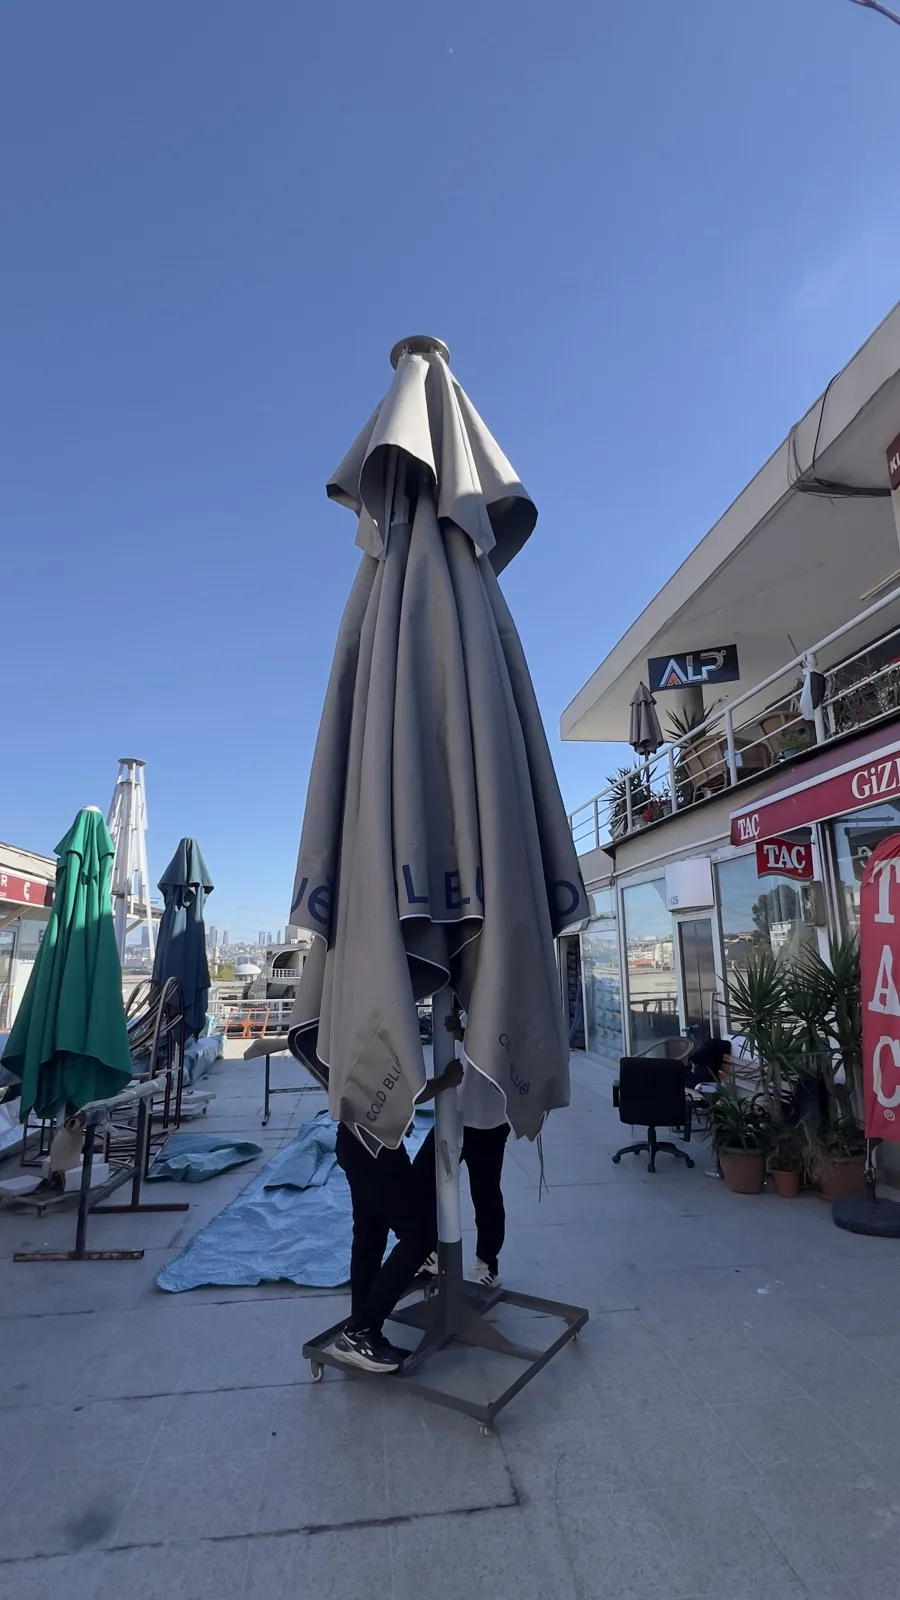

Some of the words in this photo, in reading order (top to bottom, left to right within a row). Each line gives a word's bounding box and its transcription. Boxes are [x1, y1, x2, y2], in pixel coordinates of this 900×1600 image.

[659, 651, 724, 688] ALP
[737, 813, 761, 840] TAÇ
[763, 844, 806, 874] TAÇ
[366, 1090, 387, 1122] COLD
